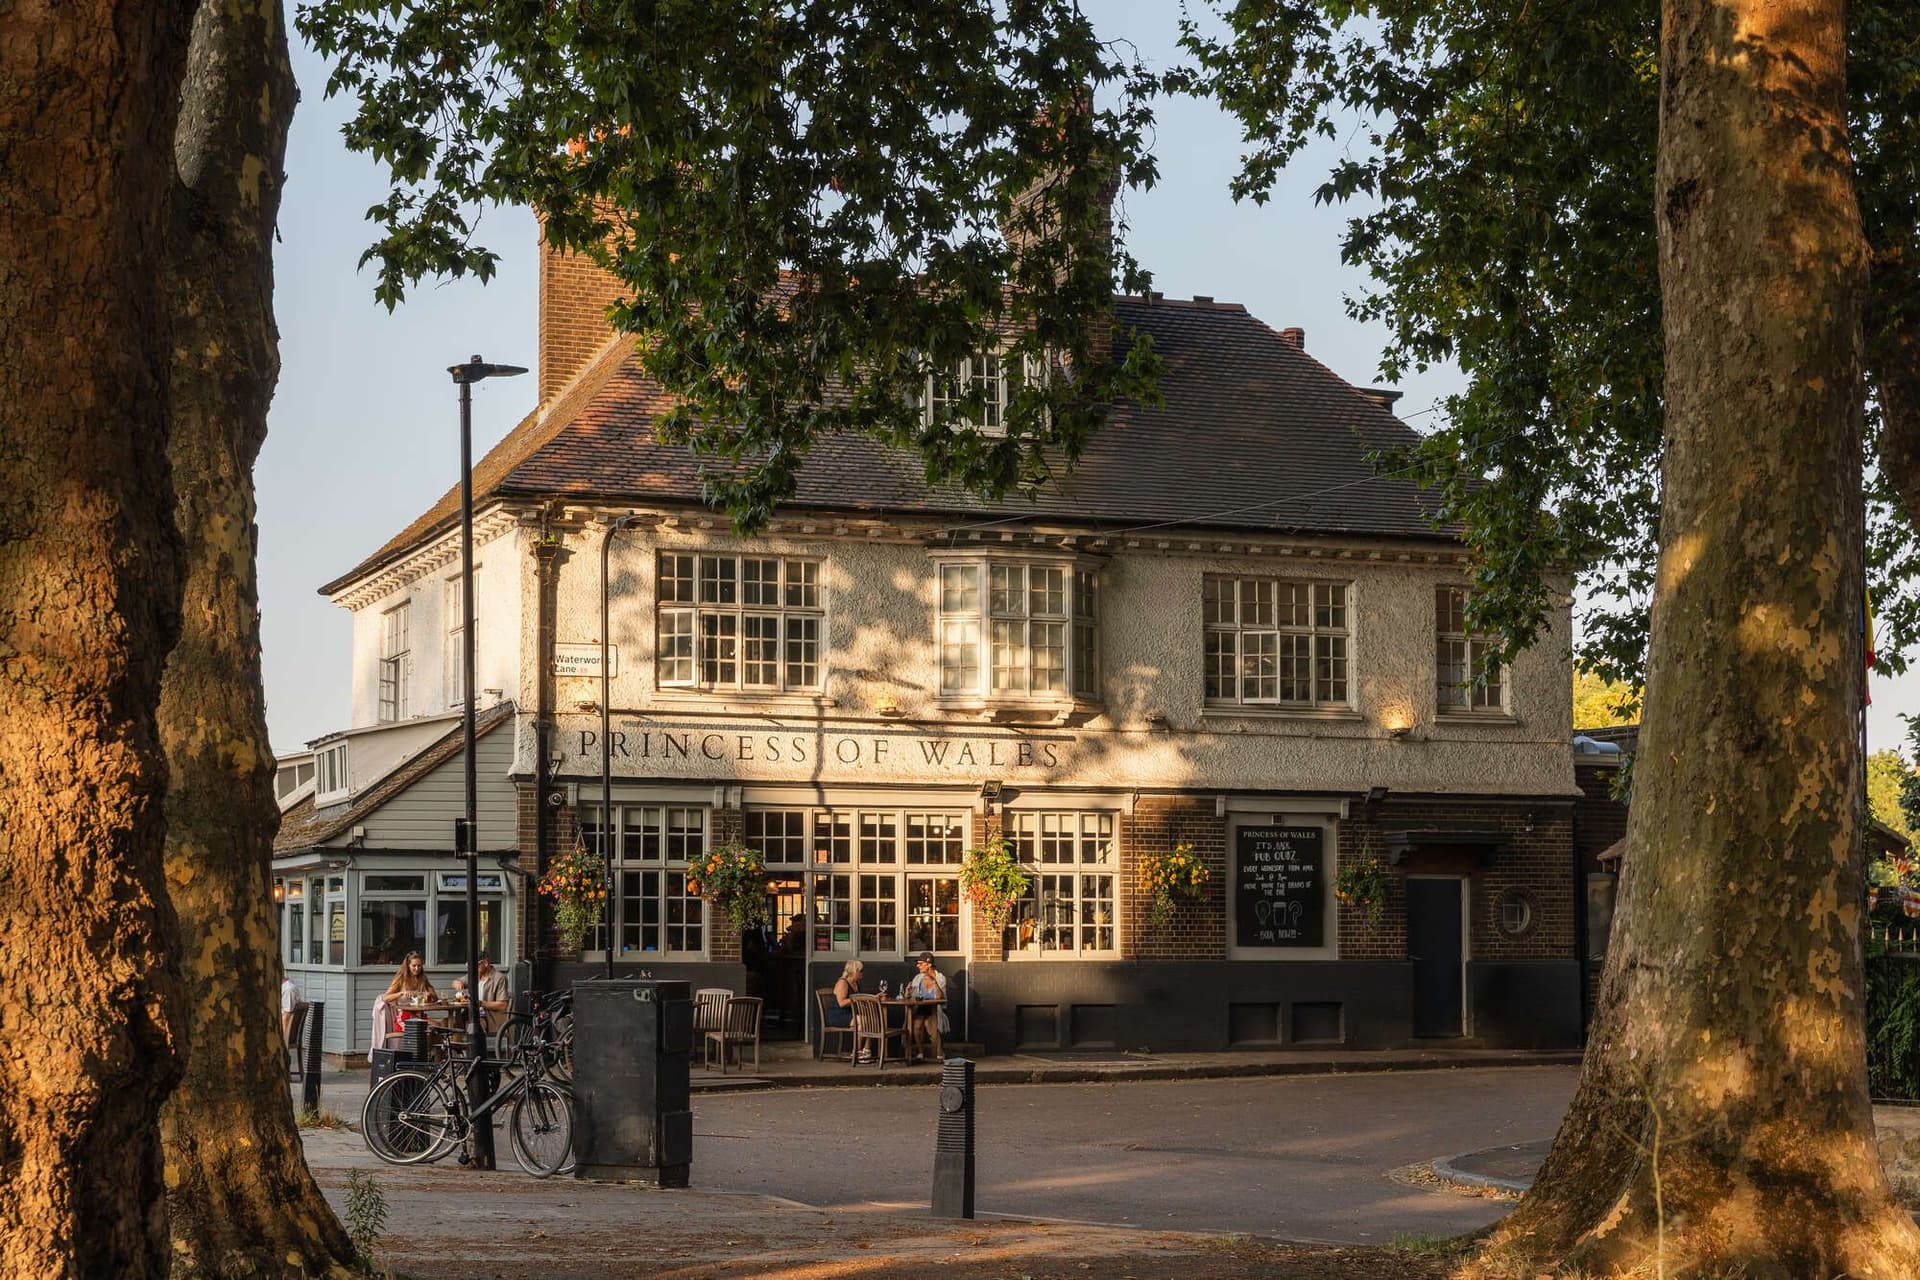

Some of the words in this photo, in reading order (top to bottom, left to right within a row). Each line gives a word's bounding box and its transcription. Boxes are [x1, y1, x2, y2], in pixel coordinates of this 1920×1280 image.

[556, 655, 611, 664] Waterwors
[555, 664, 576, 672] Lane
[579, 730, 807, 762] PRINCESS
[836, 738, 888, 764] OF
[917, 740, 1058, 768] WALES
[1255, 853, 1270, 862] PUB
[1274, 851, 1296, 861] QUIZ
